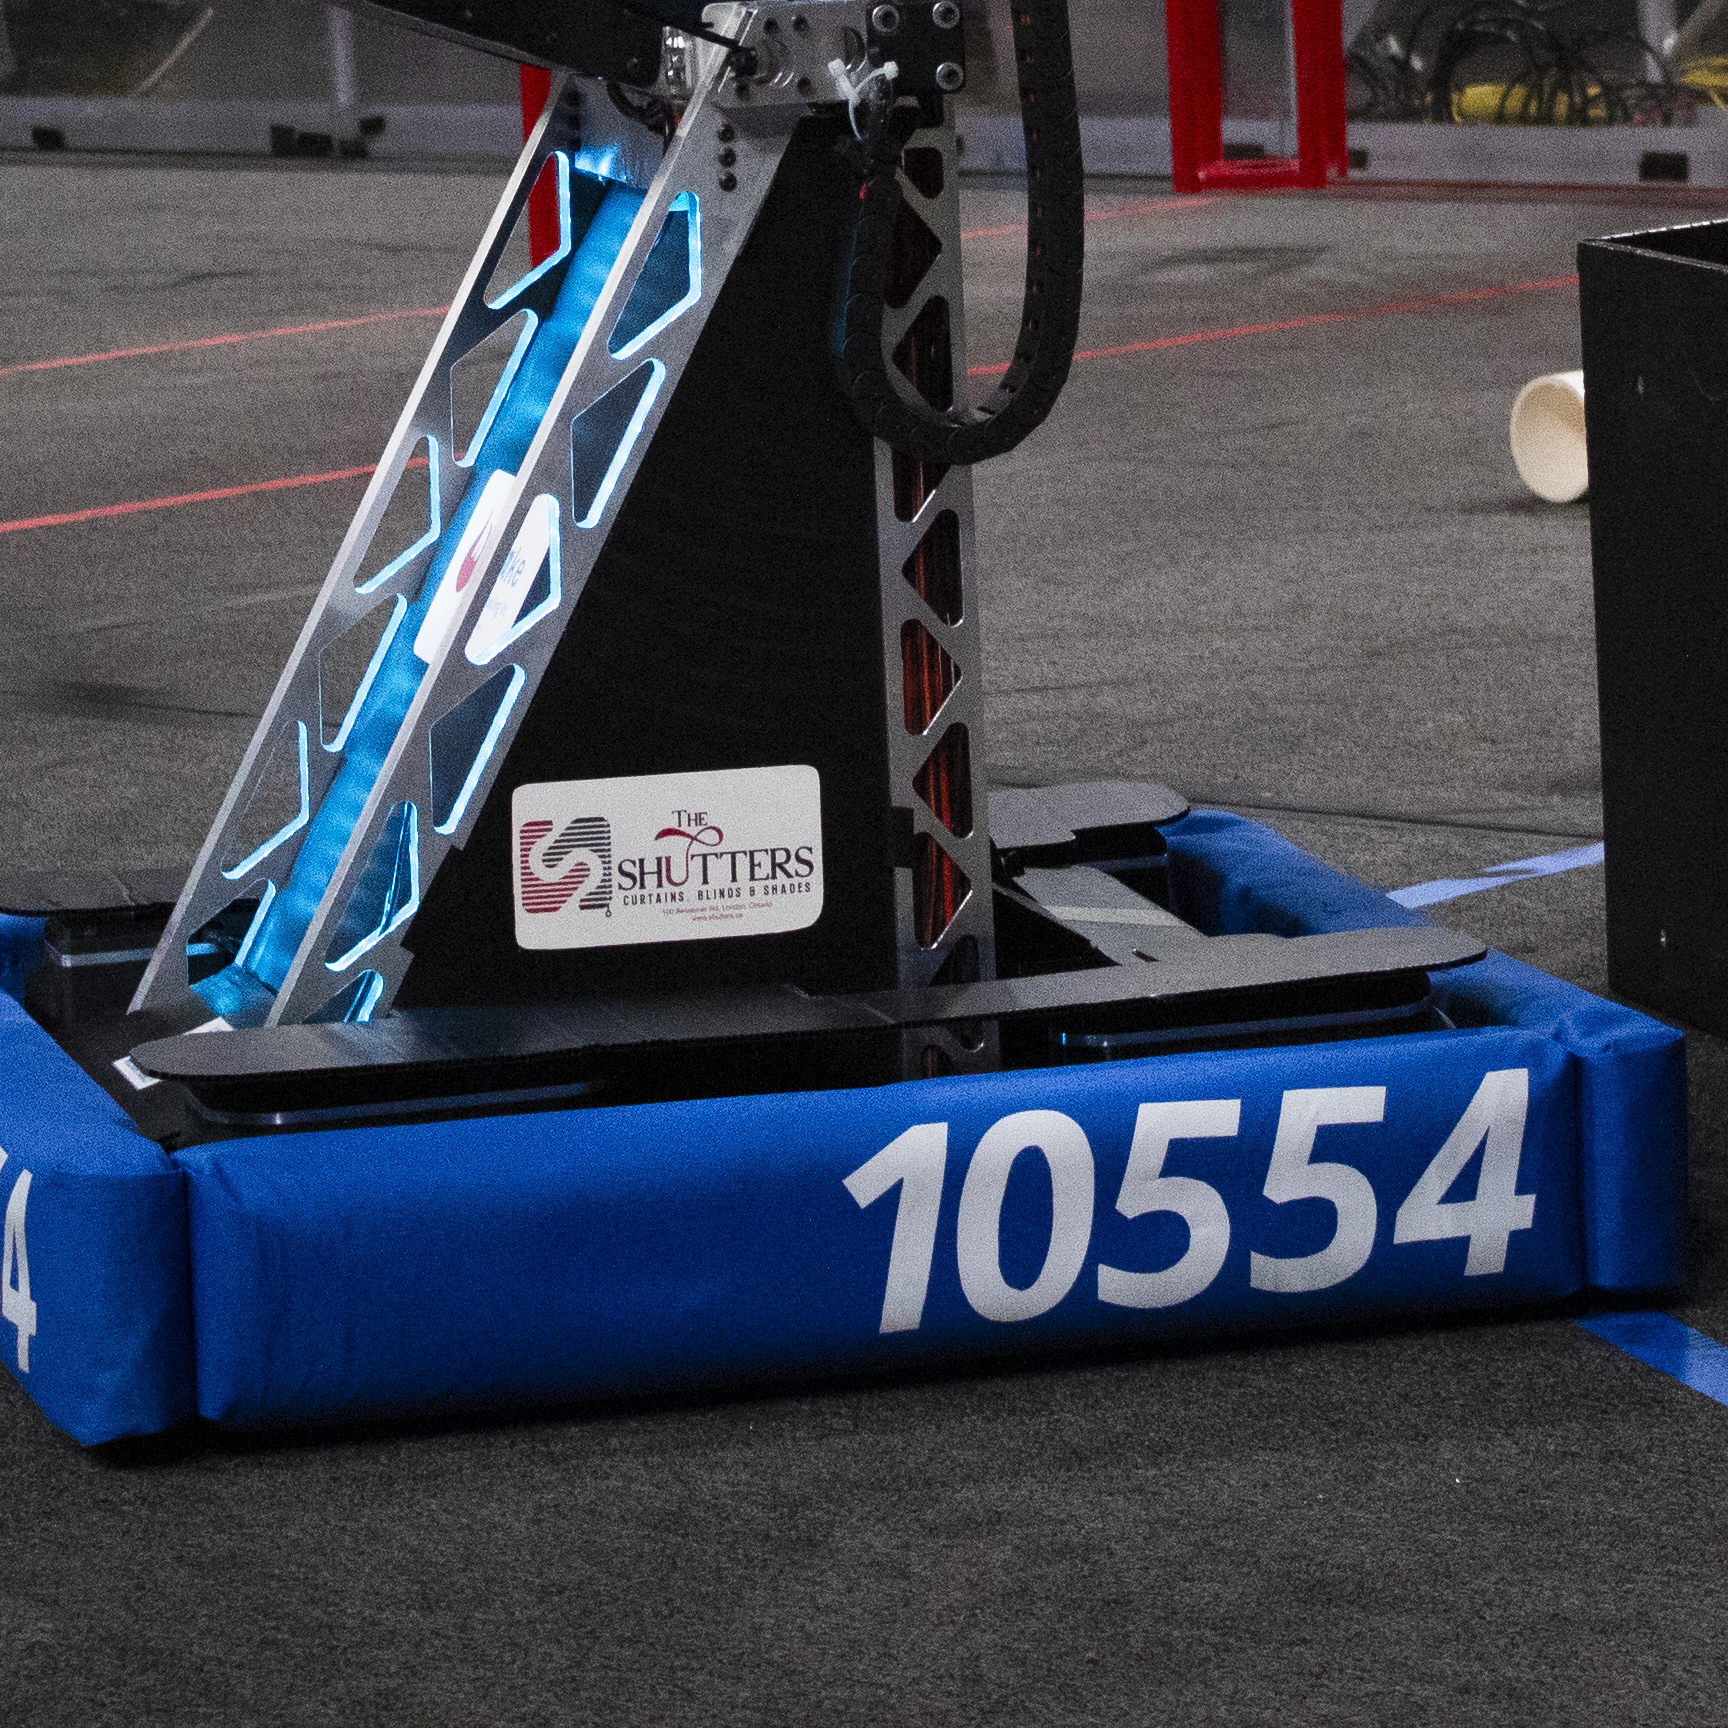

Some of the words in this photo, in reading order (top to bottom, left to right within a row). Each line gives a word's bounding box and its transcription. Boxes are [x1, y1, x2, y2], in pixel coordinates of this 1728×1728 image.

[618, 846, 814, 891] SHUTTERS
[698, 886, 741, 901] BLINDS
[749, 886, 756, 898] &
[763, 882, 812, 896] SHADES
[842, 1067, 1537, 1334] 10554
